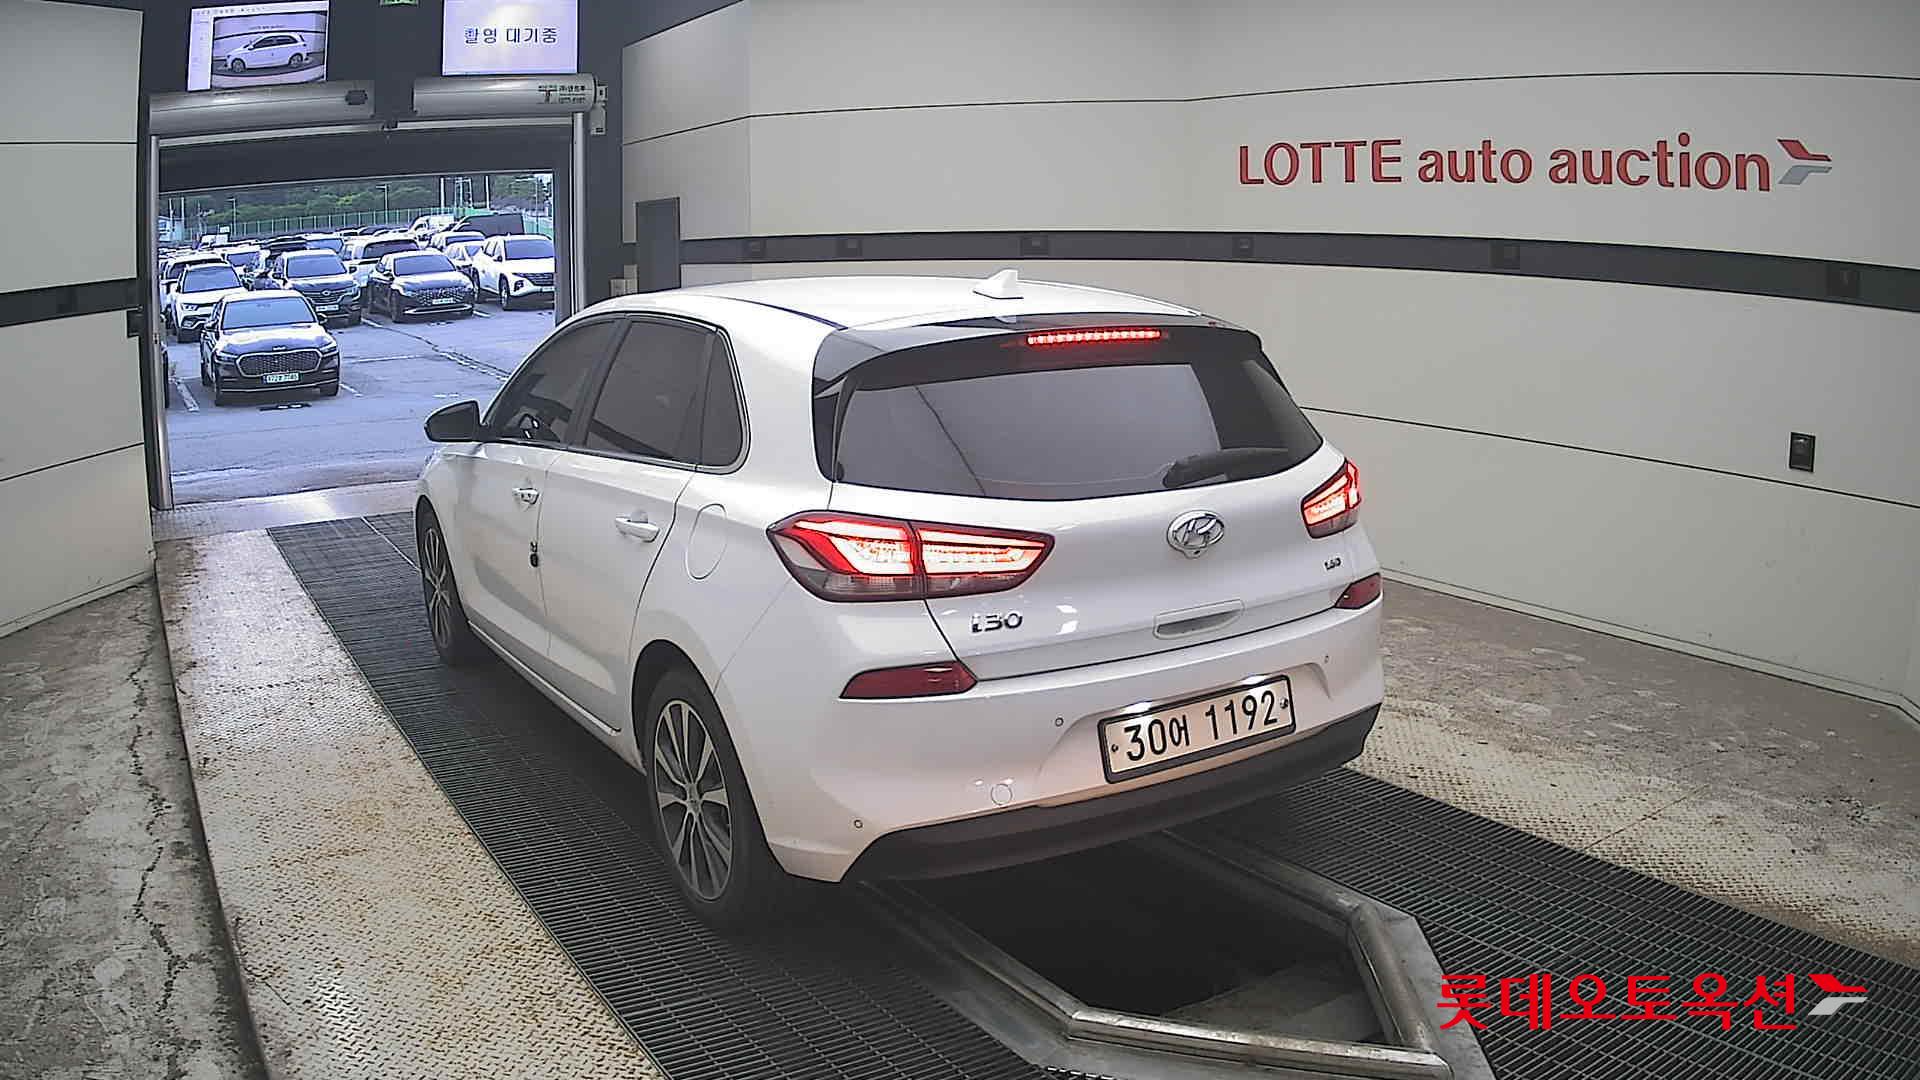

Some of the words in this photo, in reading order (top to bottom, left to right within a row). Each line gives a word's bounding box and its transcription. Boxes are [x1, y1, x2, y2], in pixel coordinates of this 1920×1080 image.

[505, 27, 558, 44] 대기중
[1238, 139, 1402, 186] LOTTE
[1417, 139, 1533, 184] auto
[1548, 132, 1771, 192] auction
[971, 613, 1023, 633] i30
[1123, 714, 1190, 762] 30어
[1205, 690, 1278, 740] 1192
